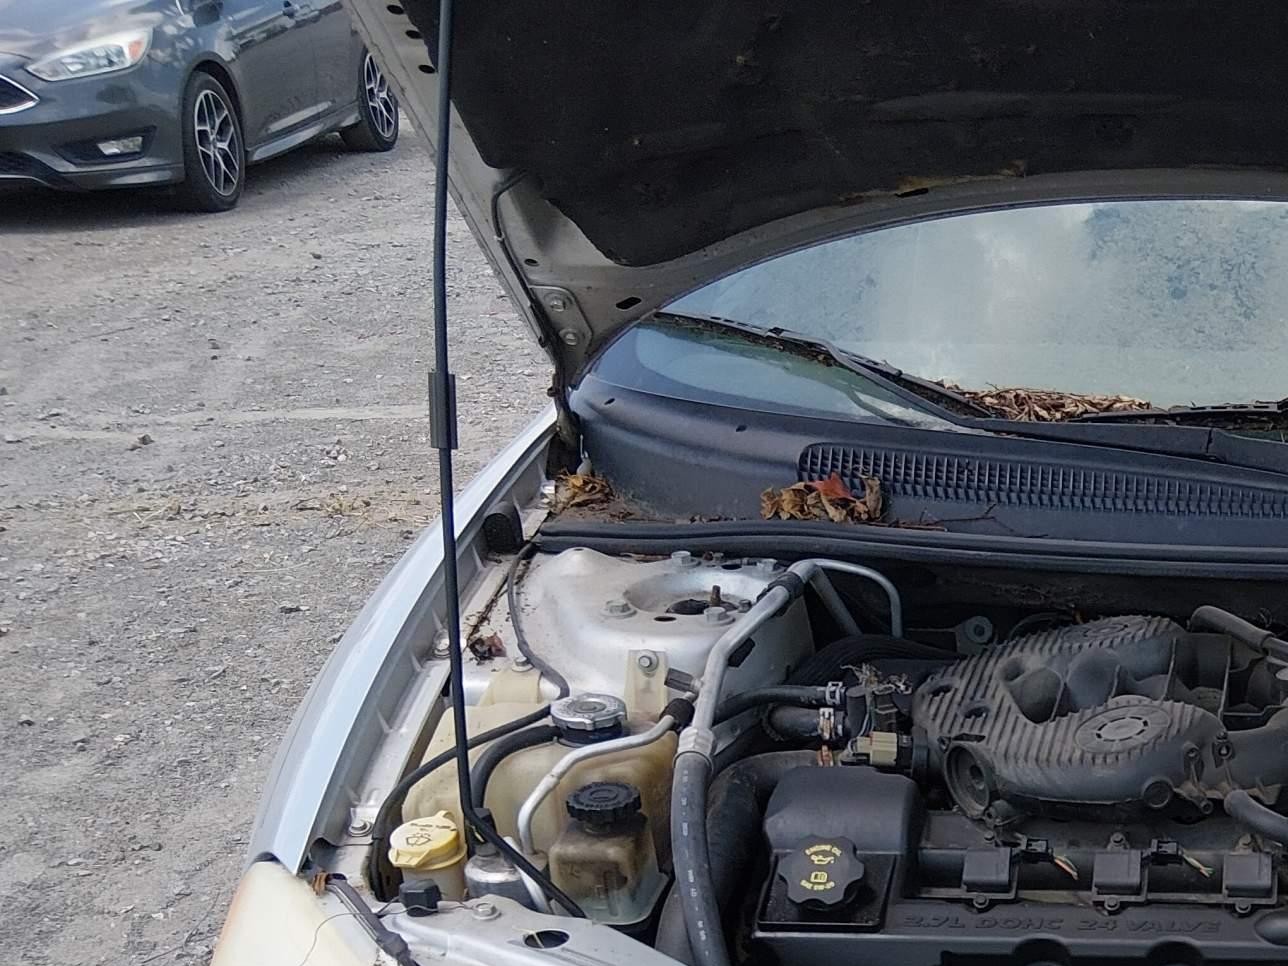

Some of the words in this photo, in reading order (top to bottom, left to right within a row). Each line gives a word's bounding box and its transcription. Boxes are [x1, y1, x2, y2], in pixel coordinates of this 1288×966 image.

[902, 915, 965, 929] 2.7L
[975, 917, 1065, 930] DOHC
[1076, 918, 1118, 931] 24
[1126, 918, 1223, 933] VALVE
